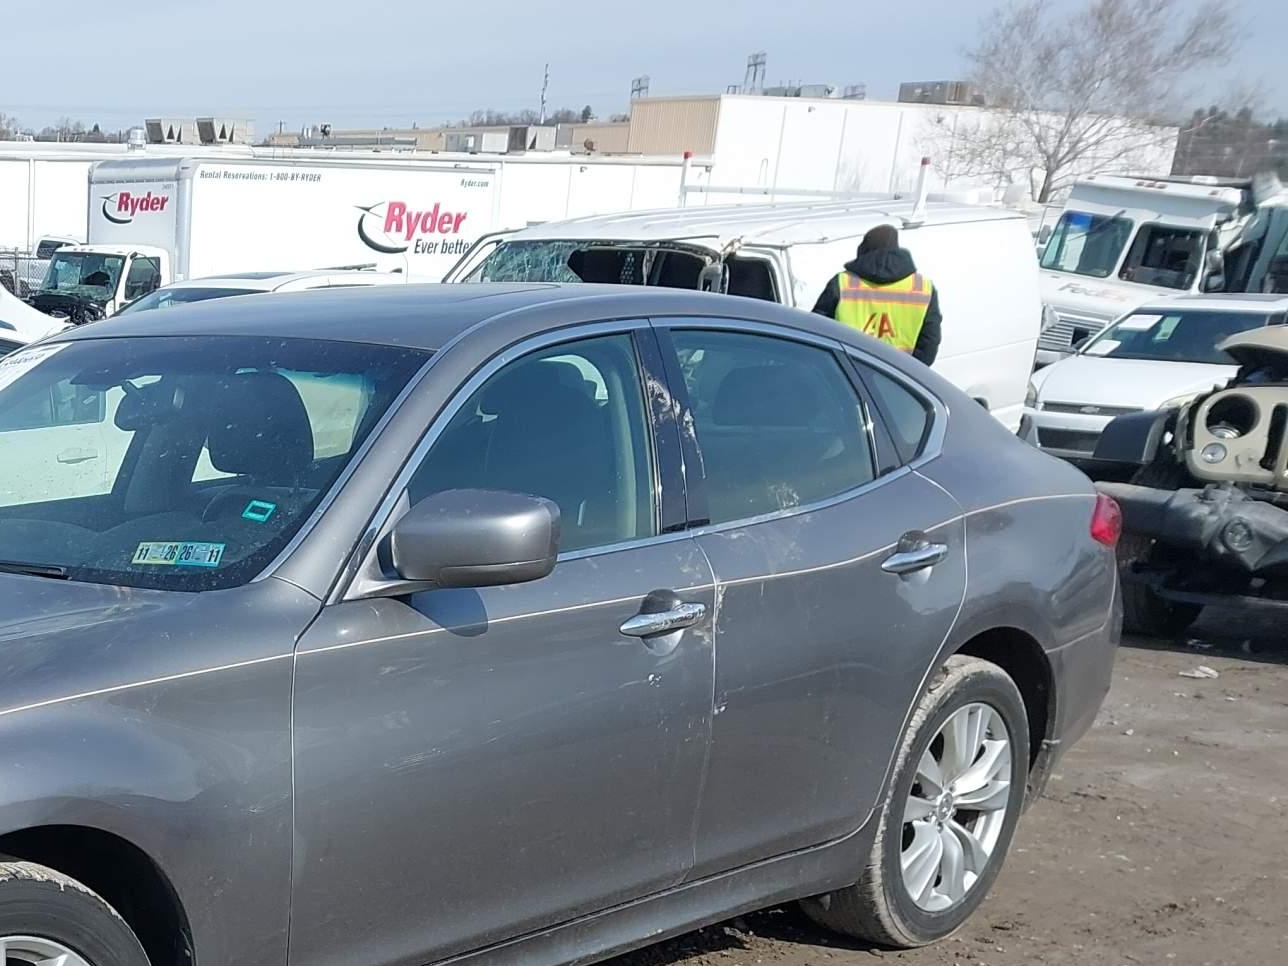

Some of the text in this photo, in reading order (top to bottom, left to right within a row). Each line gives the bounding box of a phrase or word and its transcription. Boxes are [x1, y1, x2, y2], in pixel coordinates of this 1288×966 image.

[200, 170, 222, 179] Rental
[460, 179, 489, 188] Ryder.com
[117, 191, 169, 217] Ryder
[383, 200, 468, 241] Ryder
[414, 239, 440, 255] Ever
[164, 545, 178, 560] 26
[179, 545, 193, 560] 26
